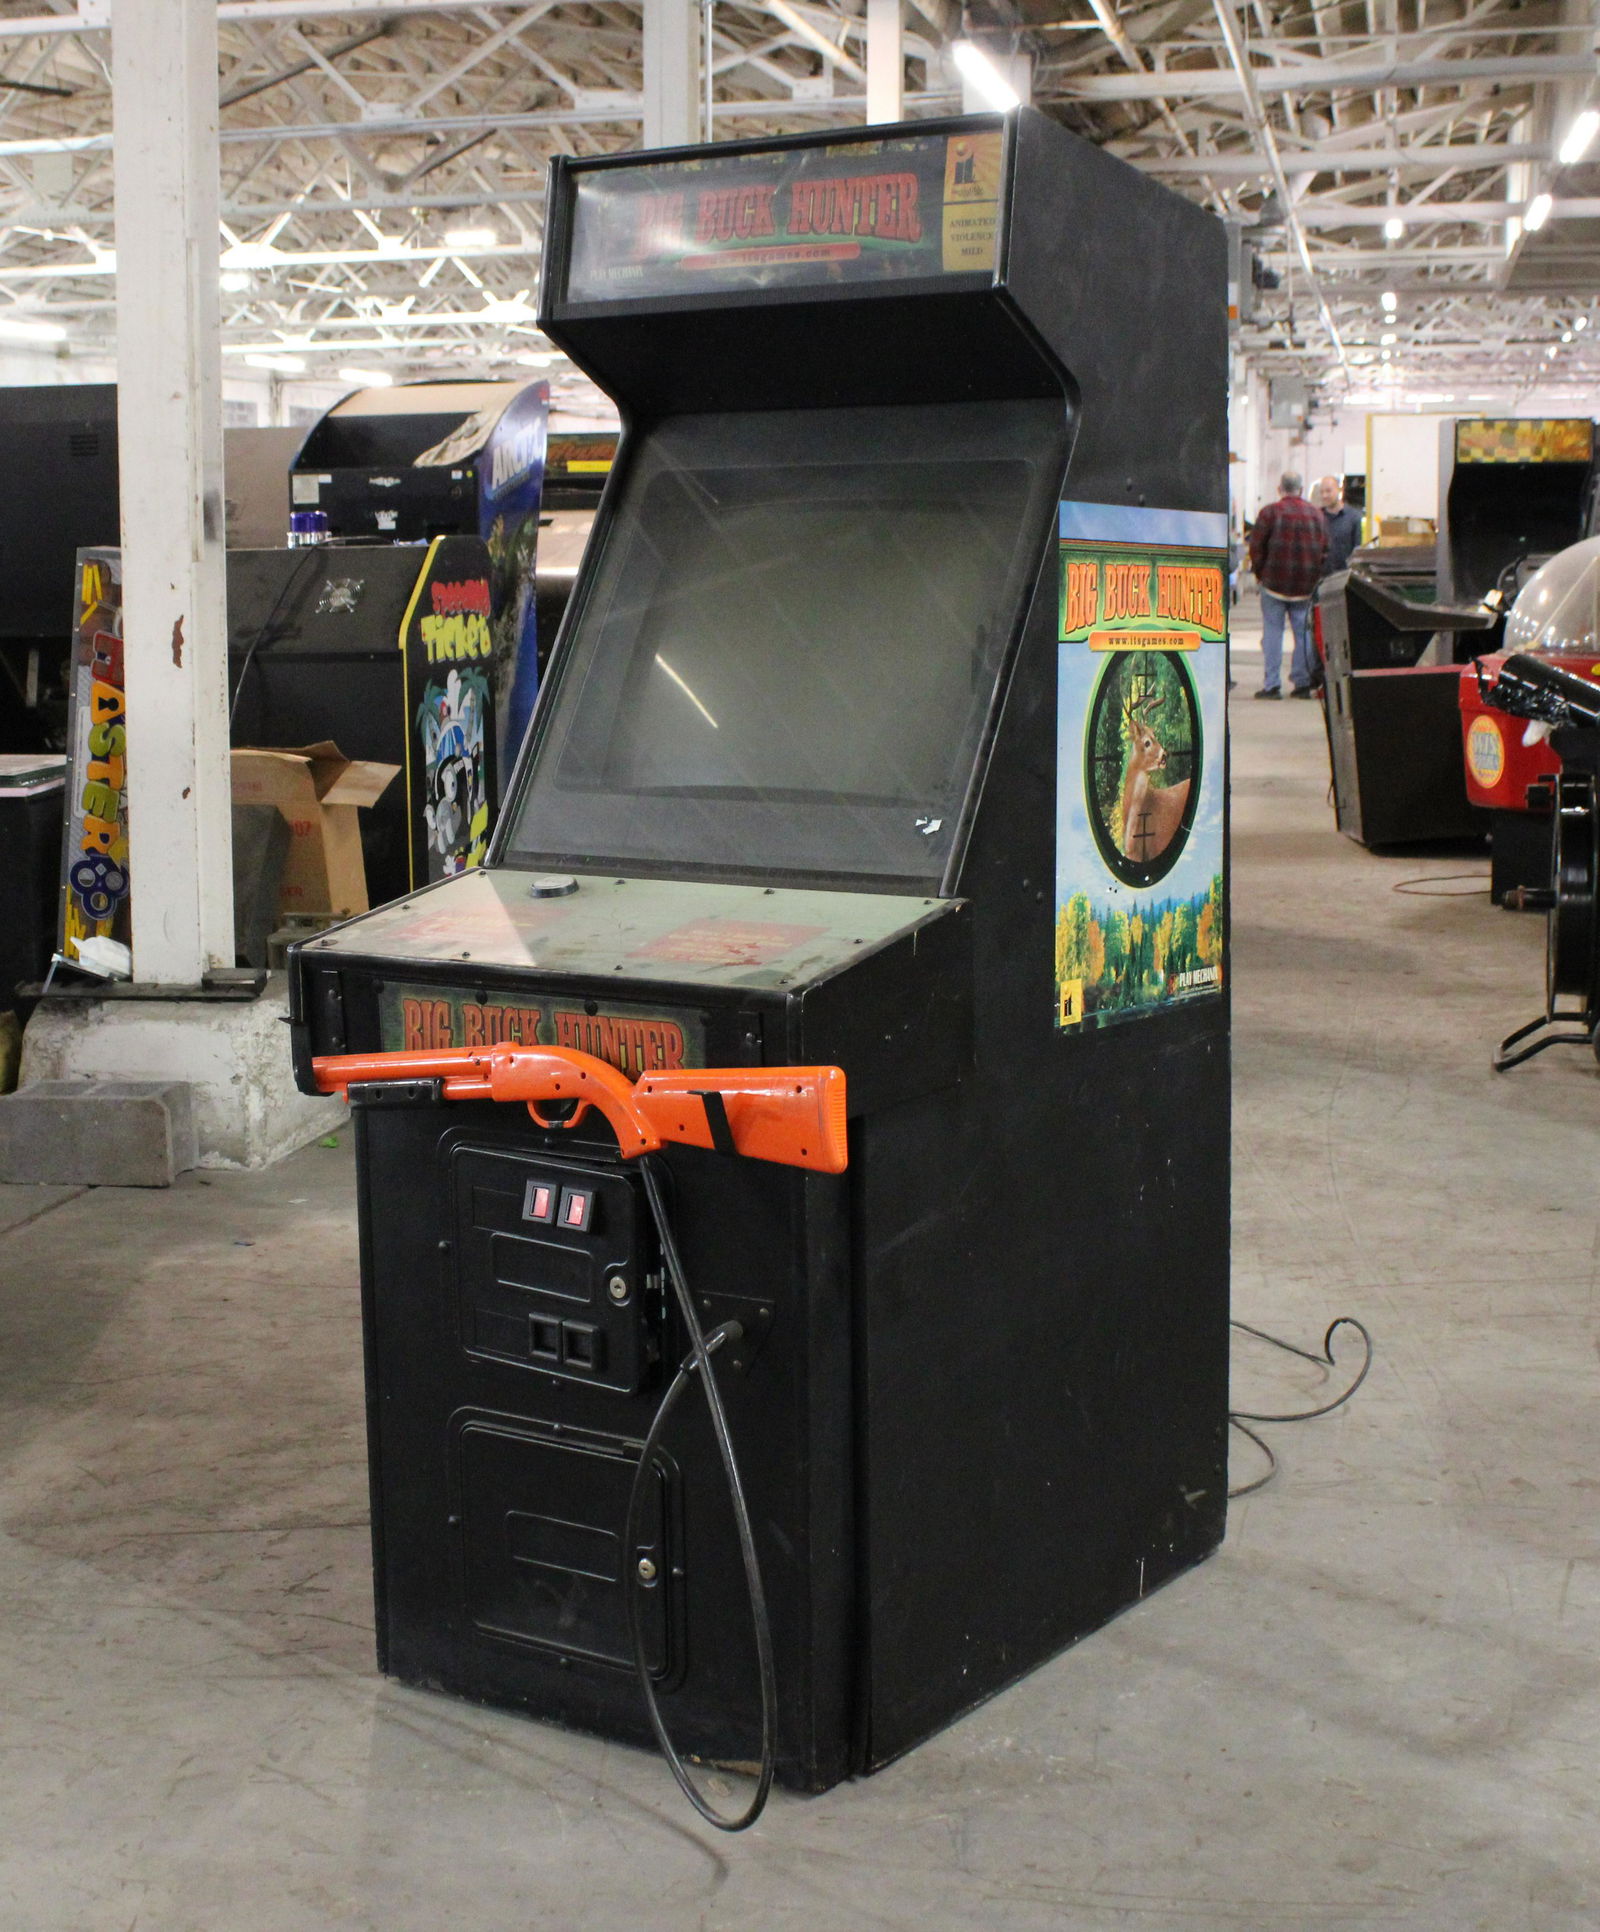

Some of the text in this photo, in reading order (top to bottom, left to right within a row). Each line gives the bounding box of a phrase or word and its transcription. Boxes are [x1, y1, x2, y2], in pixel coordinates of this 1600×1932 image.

[695, 185, 779, 244] BUCK
[787, 172, 922, 243] HUNTER
[960, 247, 984, 257] MILD
[1065, 562, 1223, 634] BIG BUCK HUNTER
[1179, 971, 1191, 988] PLAY
[403, 999, 685, 1078] BIG BUCK HUNTER
